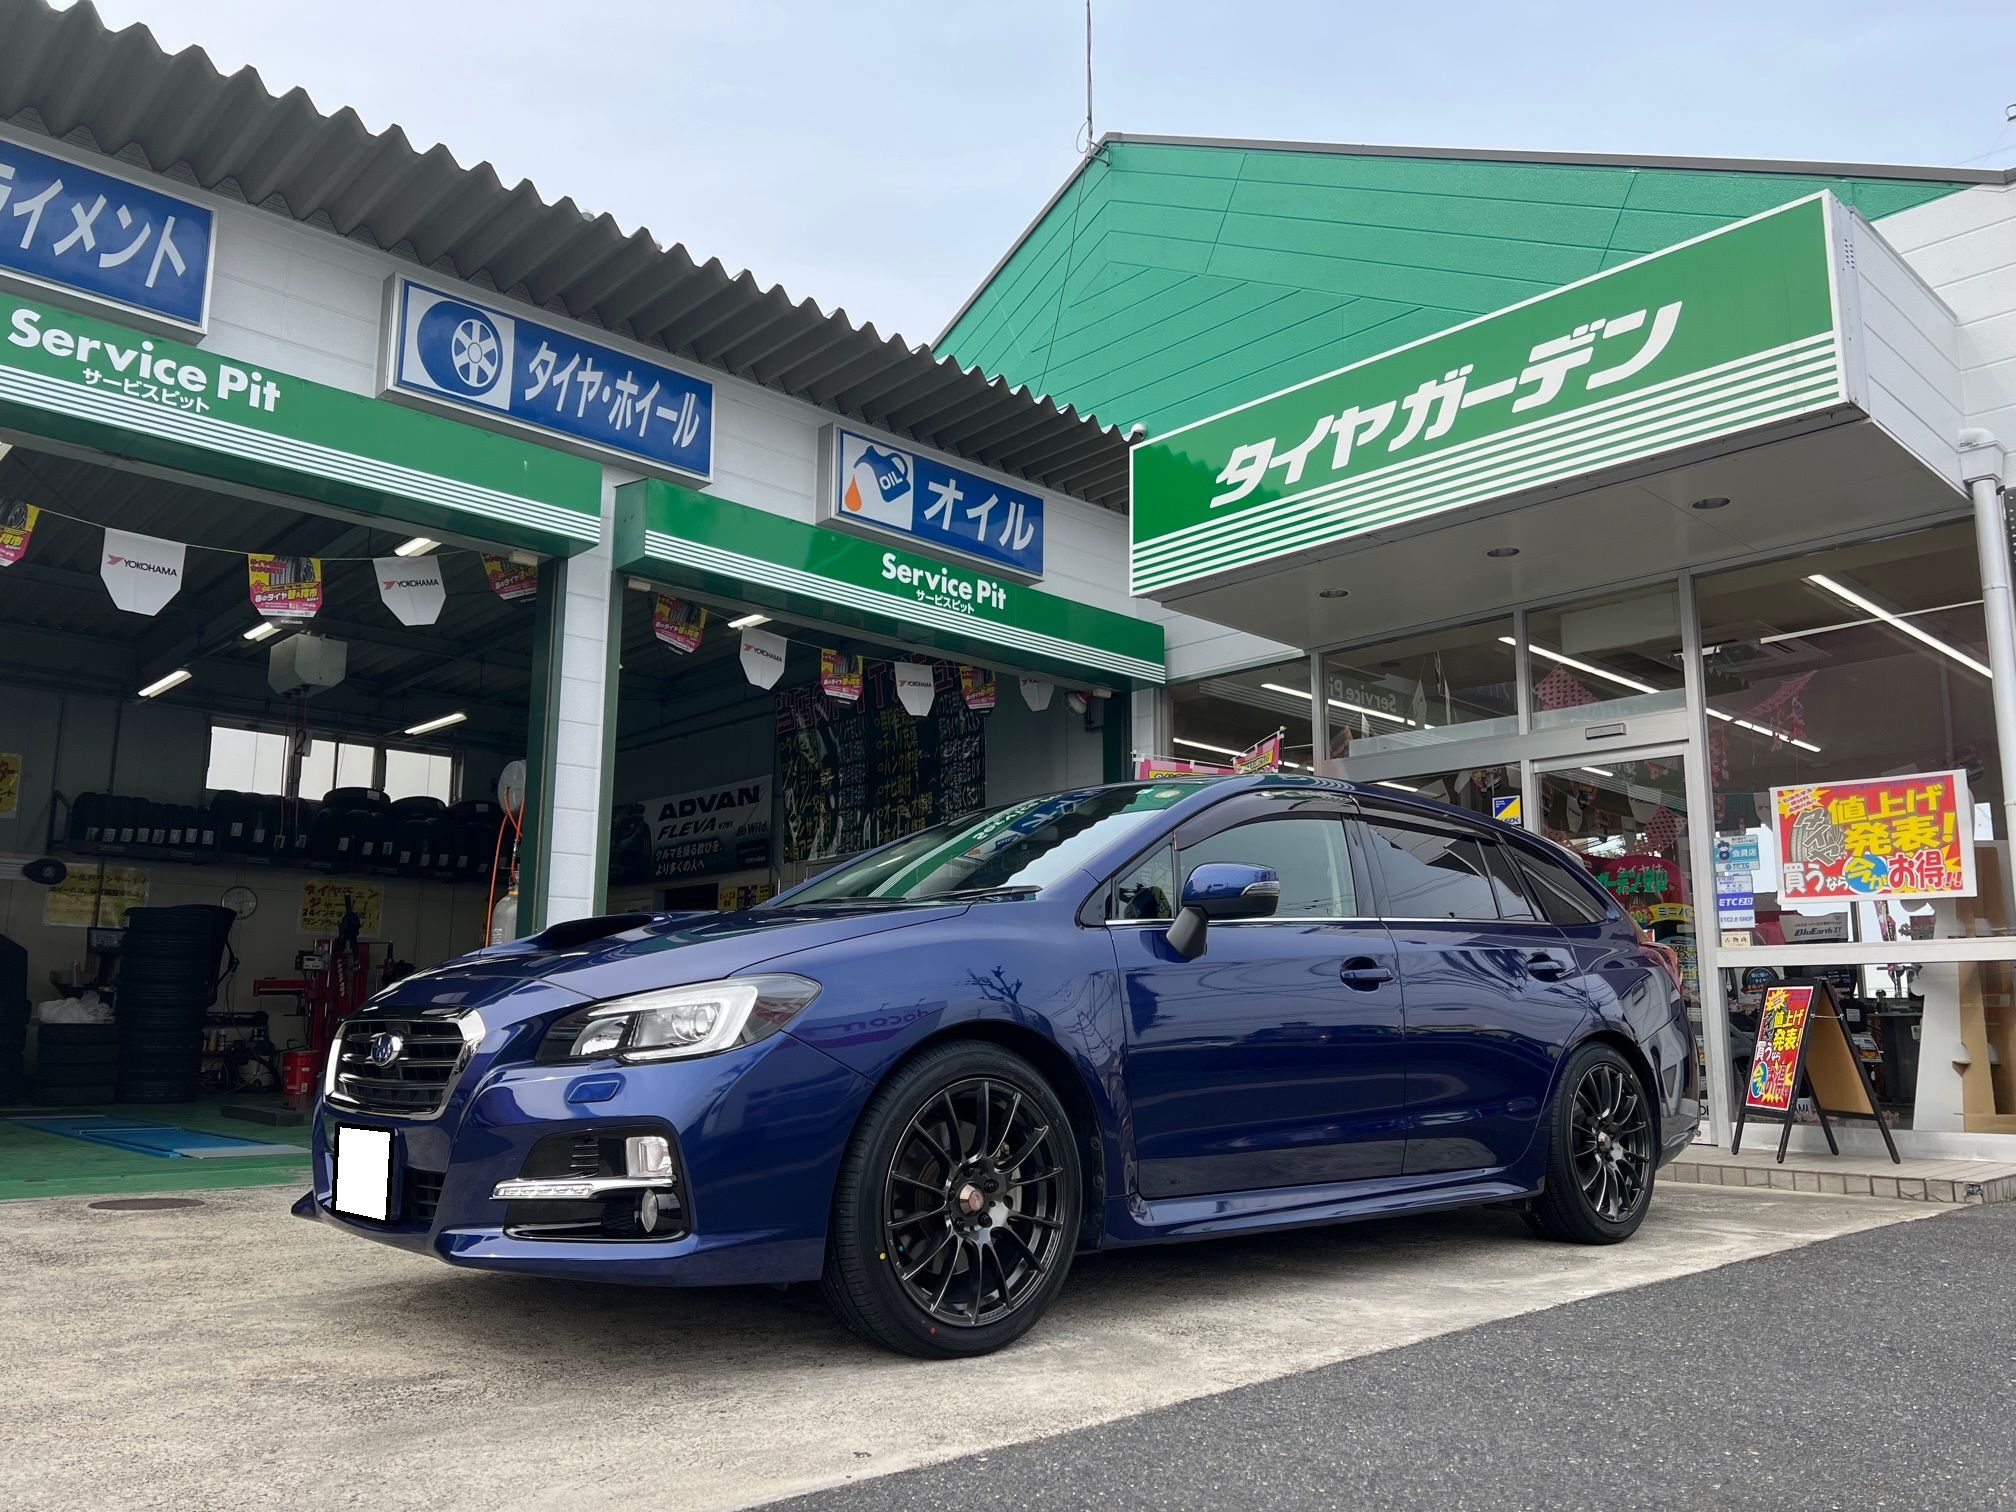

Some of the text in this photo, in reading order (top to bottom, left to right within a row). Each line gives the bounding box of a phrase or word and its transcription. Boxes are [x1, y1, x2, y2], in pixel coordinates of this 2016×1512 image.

[8, 309, 281, 412] Service Pit
[82, 368, 210, 413] サービスピット
[525, 341, 700, 448] タイヤ・ホイール
[1209, 301, 1683, 509] タイヤガーデン
[879, 470, 903, 491] OIL
[923, 479, 1035, 550] オイル
[123, 559, 178, 577] YOKOHAMA
[396, 579, 440, 588] YOKOHAMA
[881, 552, 1006, 609] Service Pit
[916, 589, 975, 614] サービスピット
[753, 646, 783, 663] YOKOHAMA
[907, 680, 932, 688] YOKOHAMA
[657, 784, 760, 822] ADVAN
[1827, 784, 1944, 825] 値上げ
[657, 816, 716, 841] FLEVA
[748, 820, 768, 834] Wild.
[1794, 808, 1841, 867] タイヤ
[1844, 812, 1956, 857] 発表!
[1731, 848, 1757, 858] 会員店
[655, 858, 705, 876] より多くの人へ
[1794, 926, 1842, 936] BluEarth-XT
[1774, 1008, 1804, 1028] 値上げ
[1755, 1041, 1781, 1061] 買うなら
[1773, 1028, 1803, 1051] 発表!
